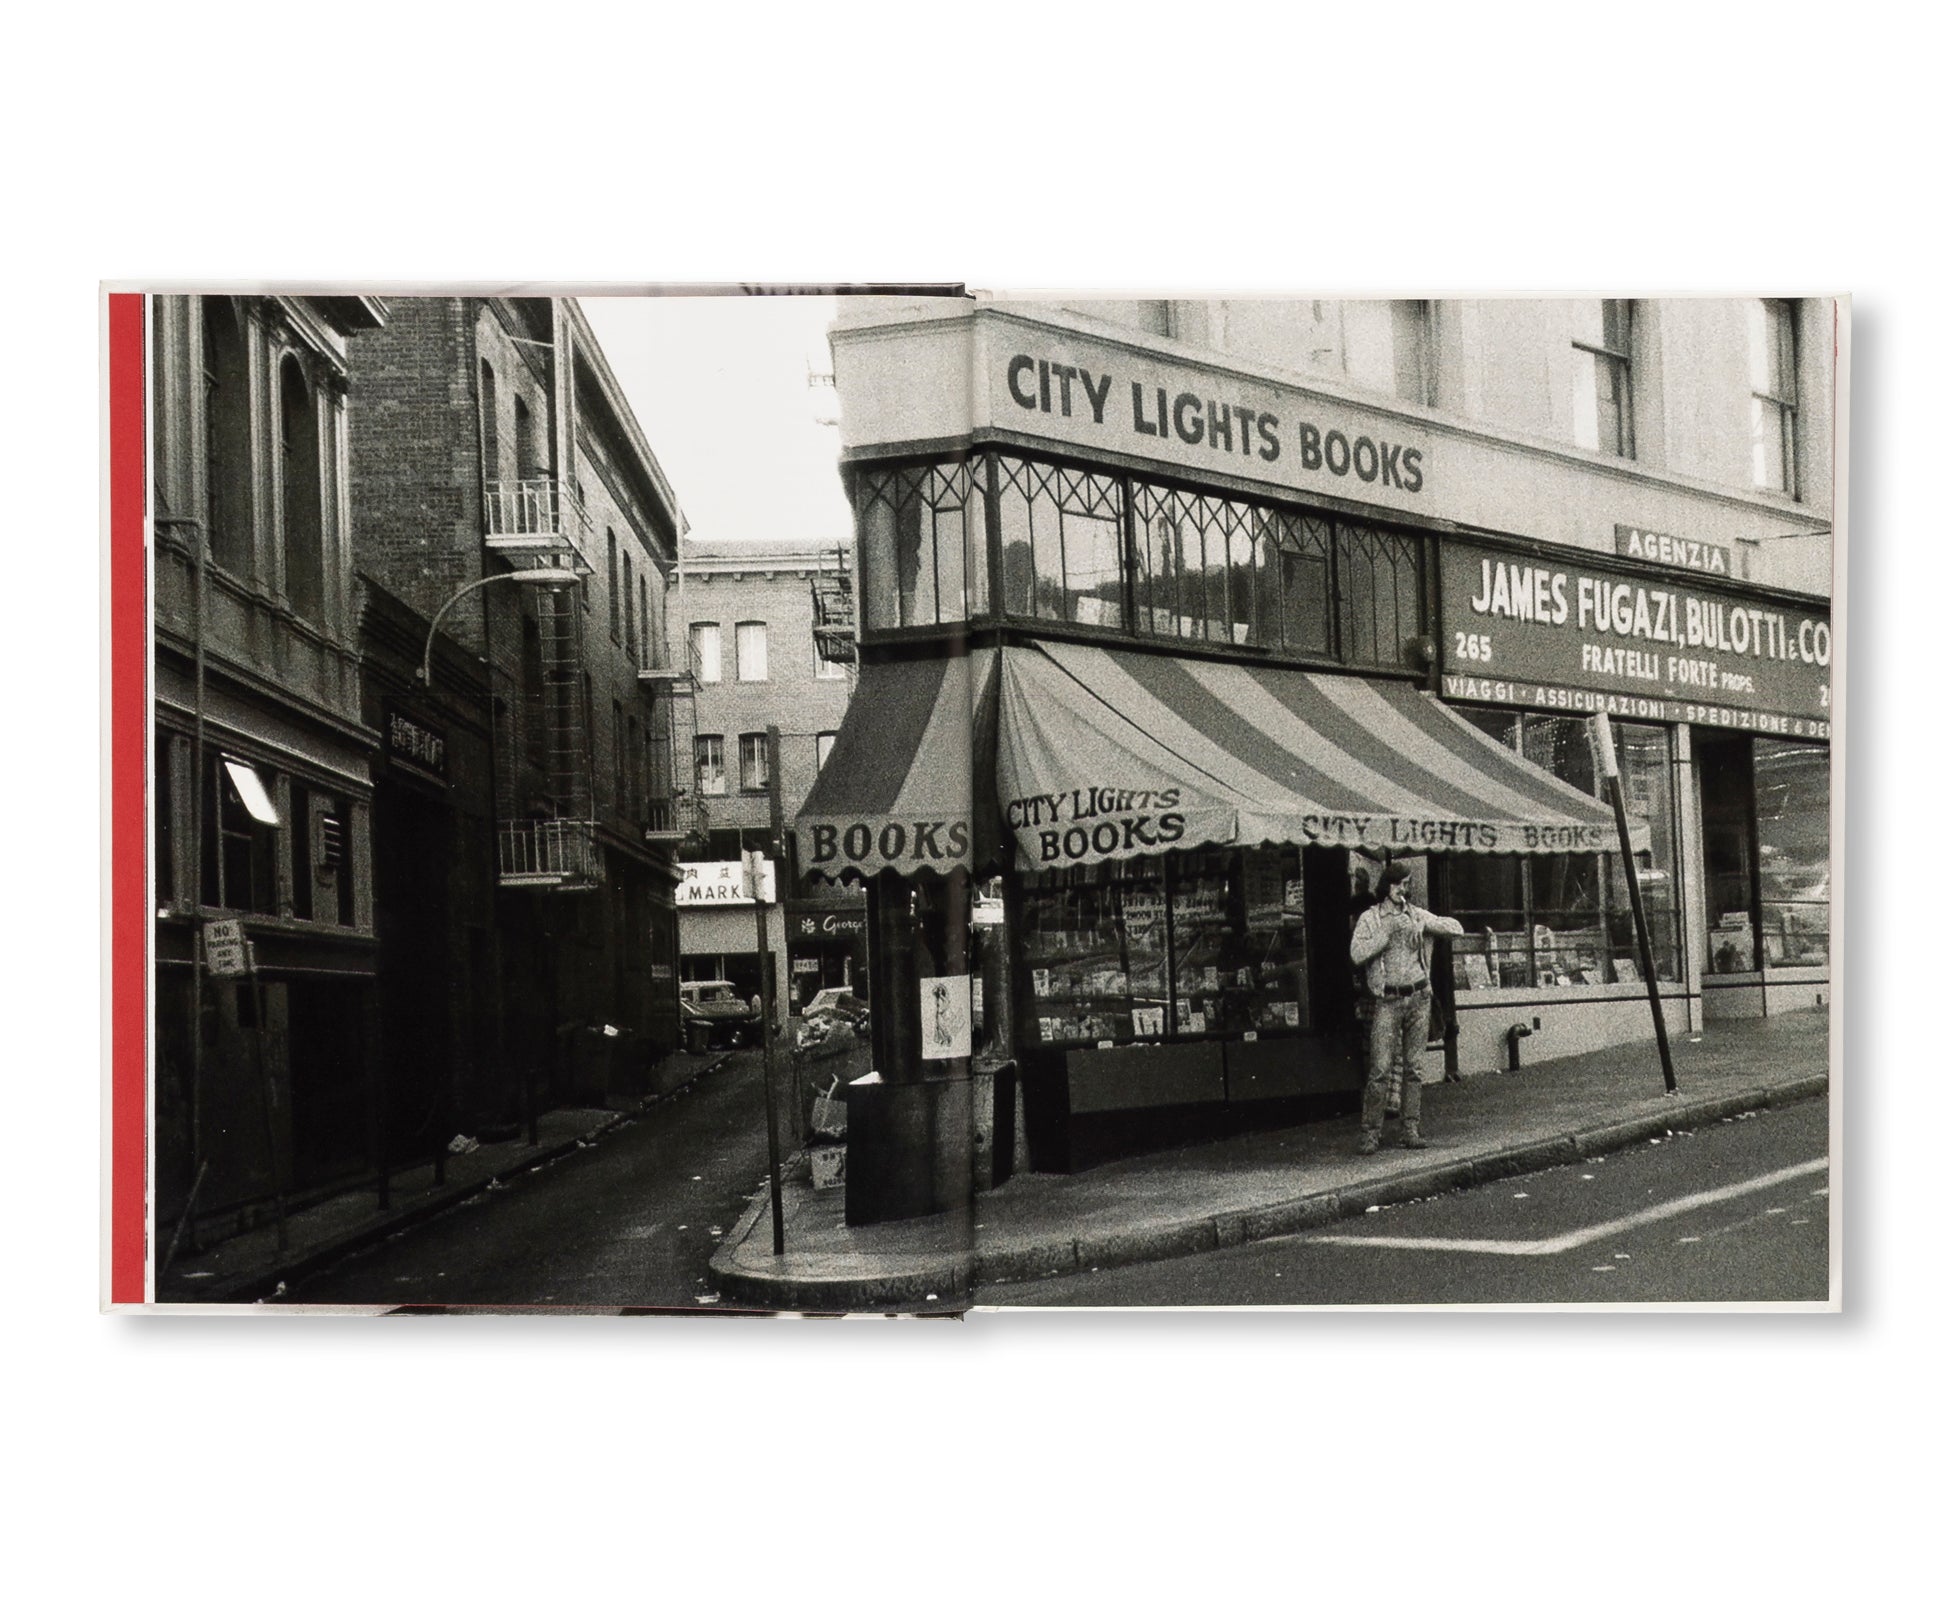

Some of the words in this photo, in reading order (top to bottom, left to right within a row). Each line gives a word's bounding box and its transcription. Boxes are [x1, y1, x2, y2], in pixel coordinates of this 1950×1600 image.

[1007, 354, 1112, 424] CITY
[1131, 381, 1280, 462] LIGHTS
[1300, 422, 1423, 493] BOOKS
[1628, 530, 1725, 573] AGENZIA
[1472, 558, 1569, 625] JAMES
[1686, 596, 1785, 660] BULOTTI
[1799, 618, 1831, 666] CO
[1455, 632, 1492, 662] 265
[1582, 643, 1659, 680] FRATELLI
[1668, 656, 1717, 688] FORTE
[1447, 678, 1514, 700] VIAGGI
[1535, 687, 1665, 719] ASSICURAZIONI
[1686, 705, 1788, 734] SPEDIZIONE
[1808, 721, 1831, 738] DE
[1007, 793, 1067, 830] CITY
[1072, 786, 1180, 821] LIGHTS
[810, 820, 969, 863] BOOKS
[1039, 813, 1185, 862] BOOKS
[1302, 814, 1371, 842] CITY
[1390, 818, 1498, 848] LIGHTS
[1523, 824, 1602, 848] BOOKS
[689, 884, 741, 901] MARK
[207, 937, 239, 949] PARKING
[213, 925, 230, 938] NO
